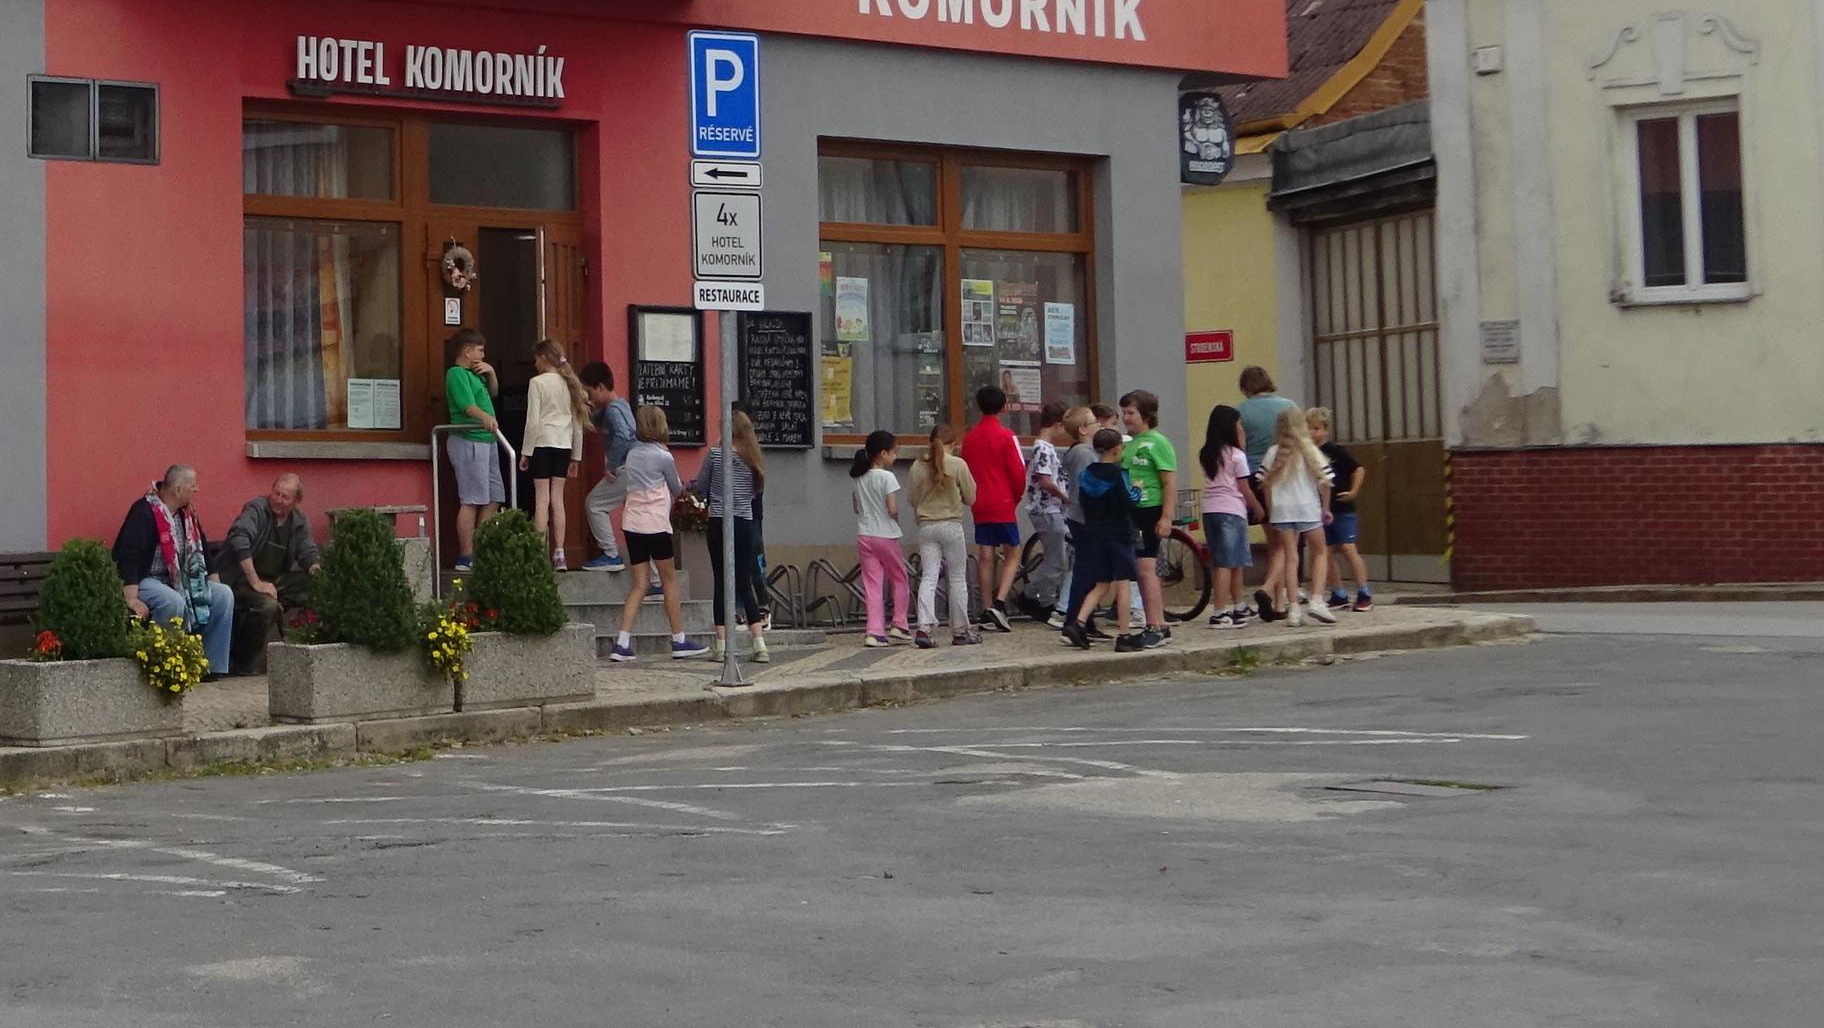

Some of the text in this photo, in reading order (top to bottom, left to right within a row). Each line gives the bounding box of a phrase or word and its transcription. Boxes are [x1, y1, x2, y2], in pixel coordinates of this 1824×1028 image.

[296, 35, 566, 99] HOTEL KOMORNÍK
[705, 48, 744, 117] P
[699, 123, 754, 142] RÉSERVÉ
[716, 202, 738, 226] 4x
[711, 236, 744, 248] HOTEL
[701, 252, 756, 266] KOMORNÍK
[699, 288, 760, 304] RESTAURACE
